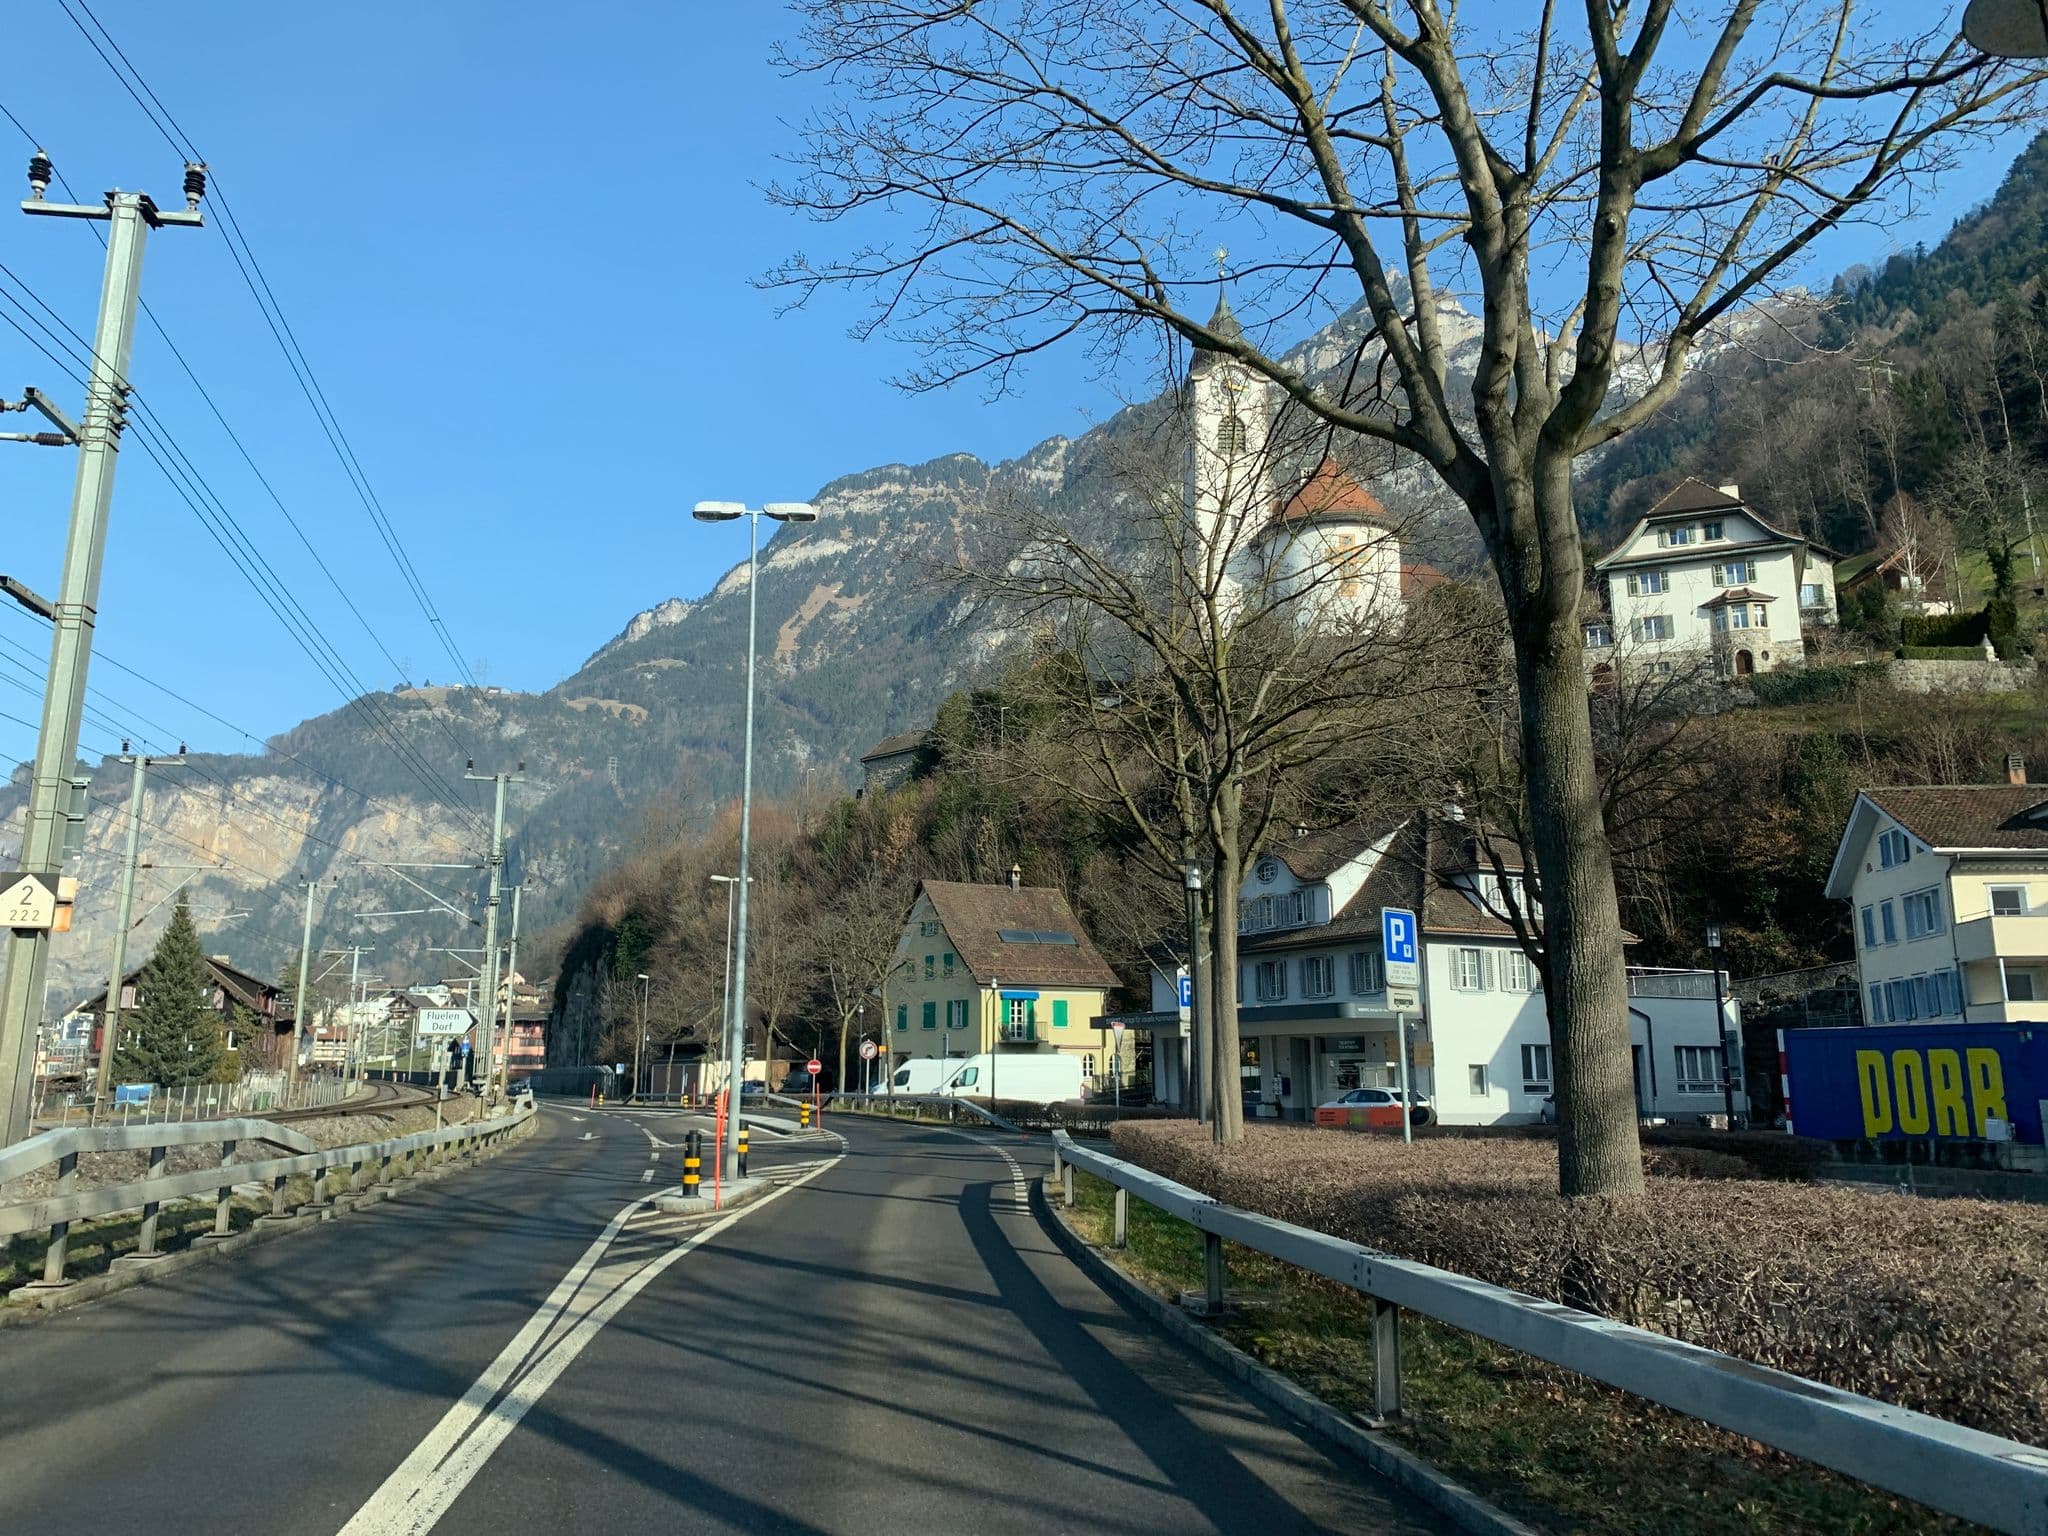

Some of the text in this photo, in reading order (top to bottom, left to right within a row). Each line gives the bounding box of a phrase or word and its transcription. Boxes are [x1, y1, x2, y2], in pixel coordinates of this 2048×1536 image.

[20, 885, 33, 905] 2
[9, 909, 40, 921] 222
[1390, 917, 1405, 954] P
[432, 1022, 453, 1031] Dorf
